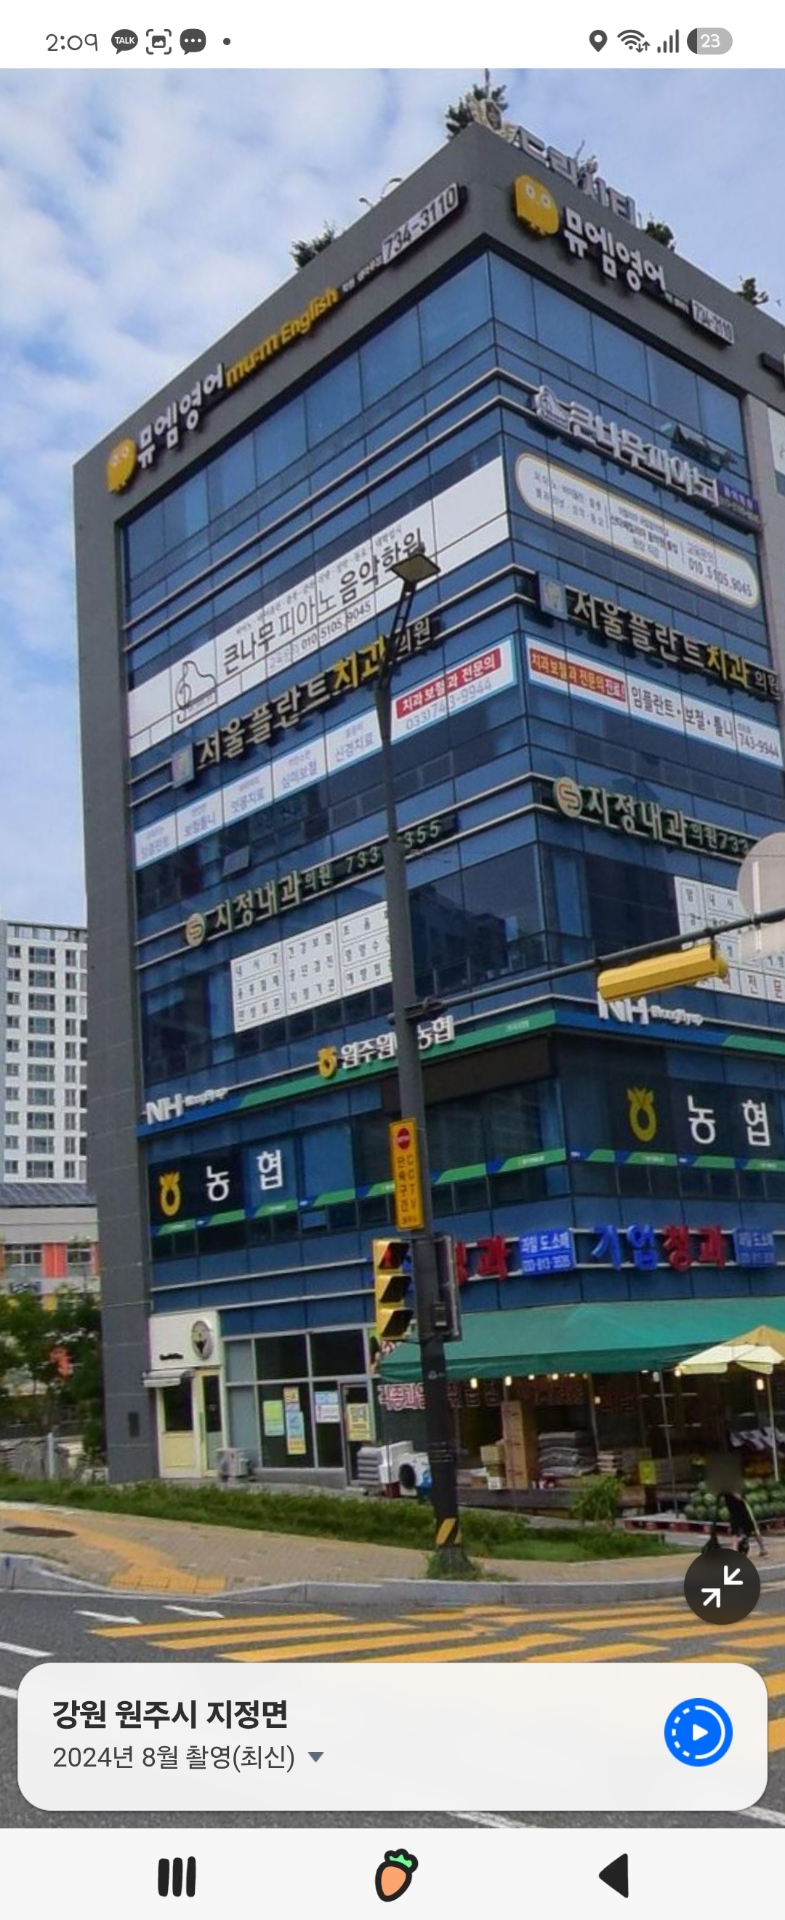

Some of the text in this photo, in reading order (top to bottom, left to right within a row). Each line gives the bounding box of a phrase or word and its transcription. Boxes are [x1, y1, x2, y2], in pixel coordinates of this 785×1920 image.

[383, 186, 457, 261] 734-3110
[563, 206, 666, 292] 뮤엠영어
[281, 286, 339, 346] English
[138, 363, 224, 469] 뮤엠영어
[597, 991, 650, 1026] NH
[145, 1092, 184, 1126] NH
